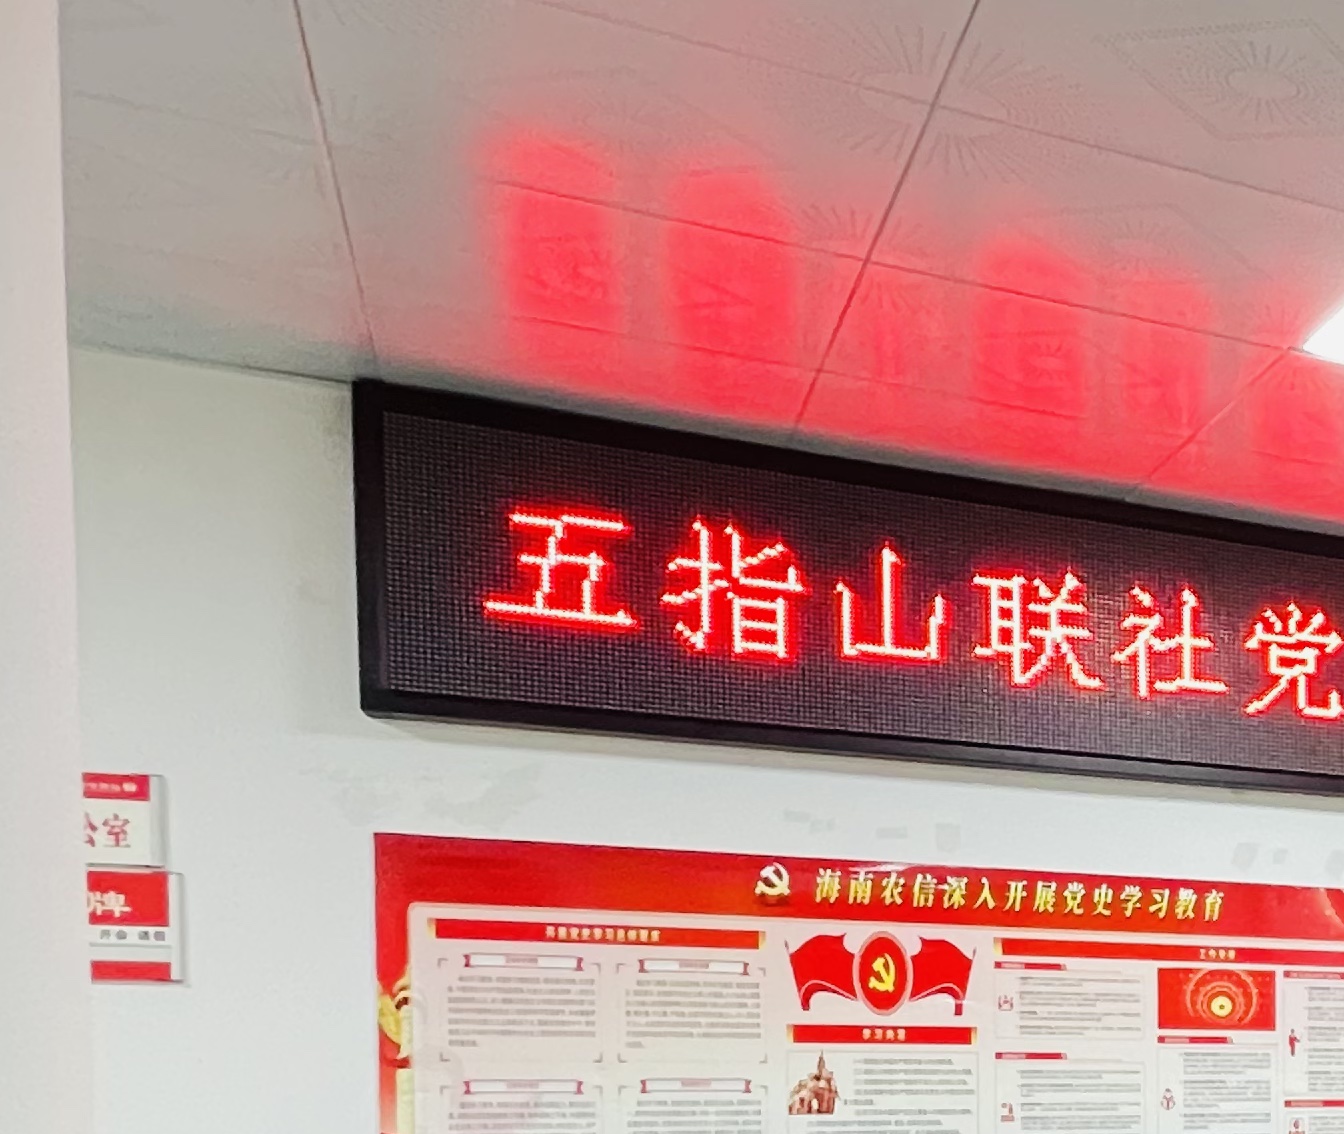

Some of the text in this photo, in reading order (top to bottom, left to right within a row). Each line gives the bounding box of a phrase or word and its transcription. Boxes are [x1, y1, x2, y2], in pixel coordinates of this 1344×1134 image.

[815, 867, 1225, 922] 海南农信深入开展党史学习教育
